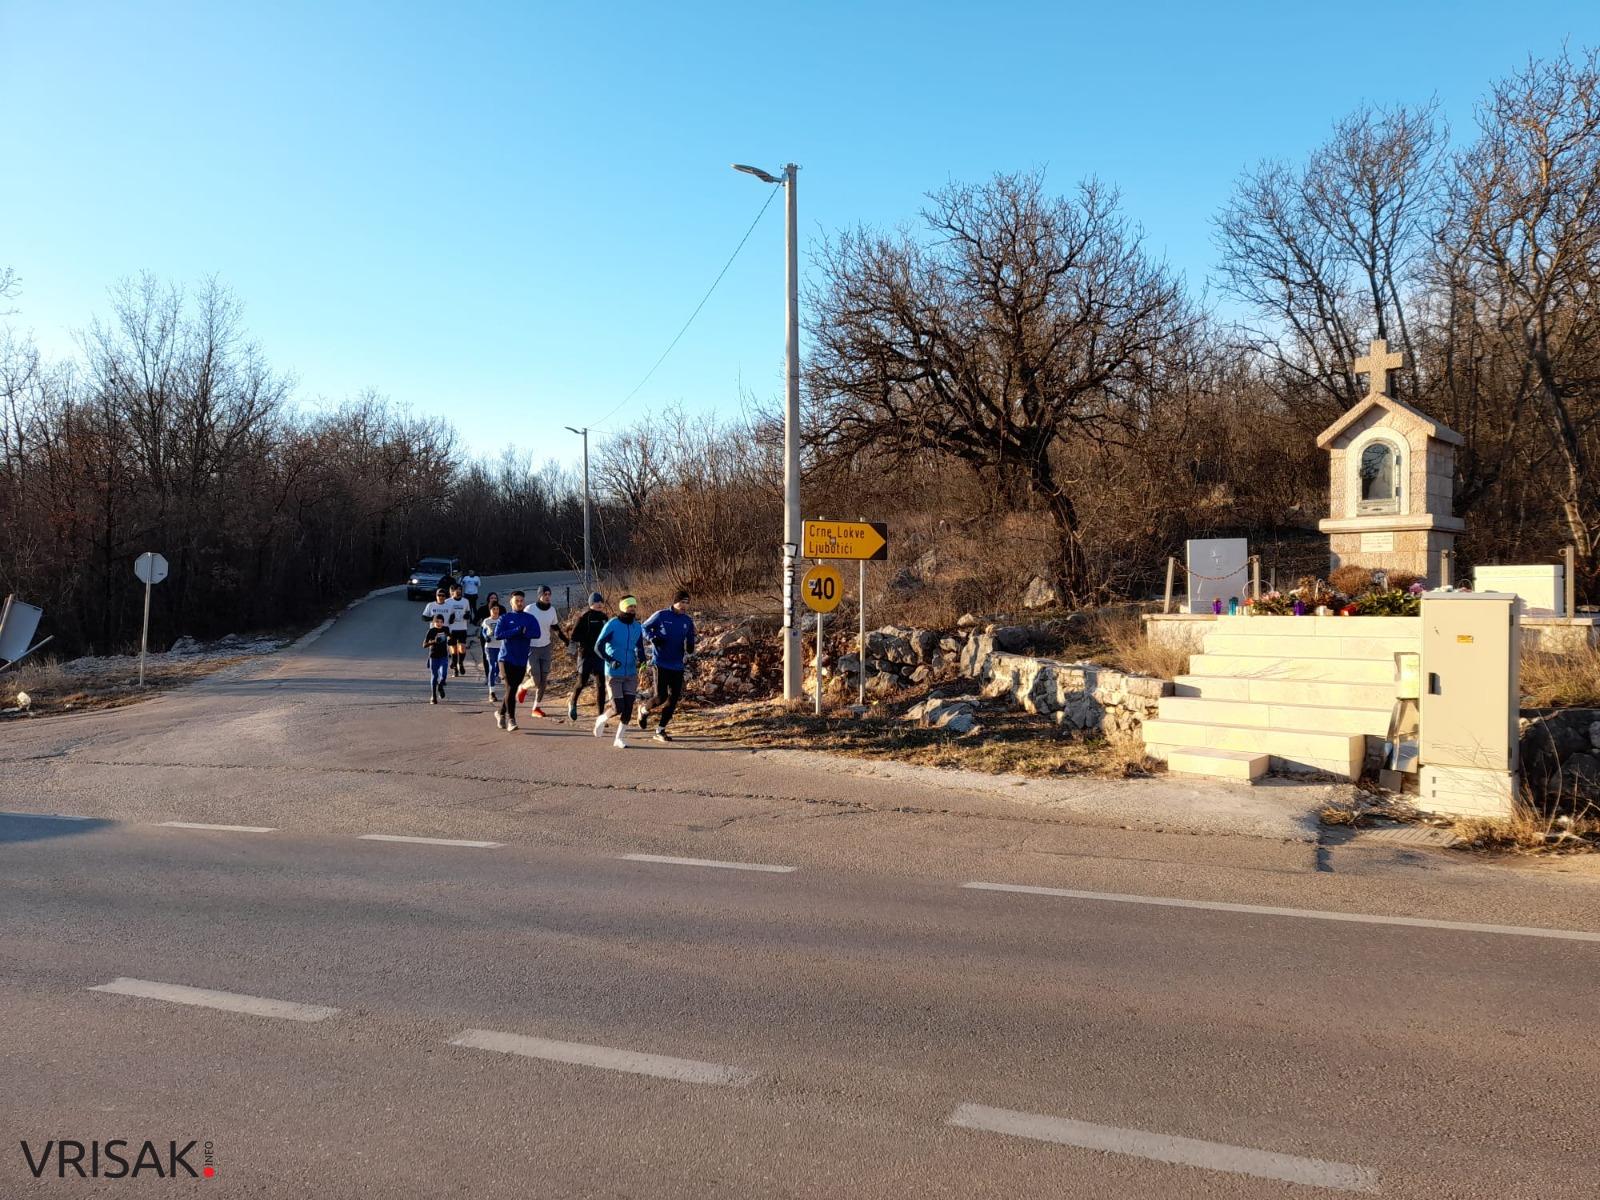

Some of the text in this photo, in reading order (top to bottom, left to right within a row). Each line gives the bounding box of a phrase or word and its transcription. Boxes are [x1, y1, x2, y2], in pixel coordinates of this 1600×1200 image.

[809, 524, 865, 539] Crne Lokve
[811, 577, 835, 600] 40
